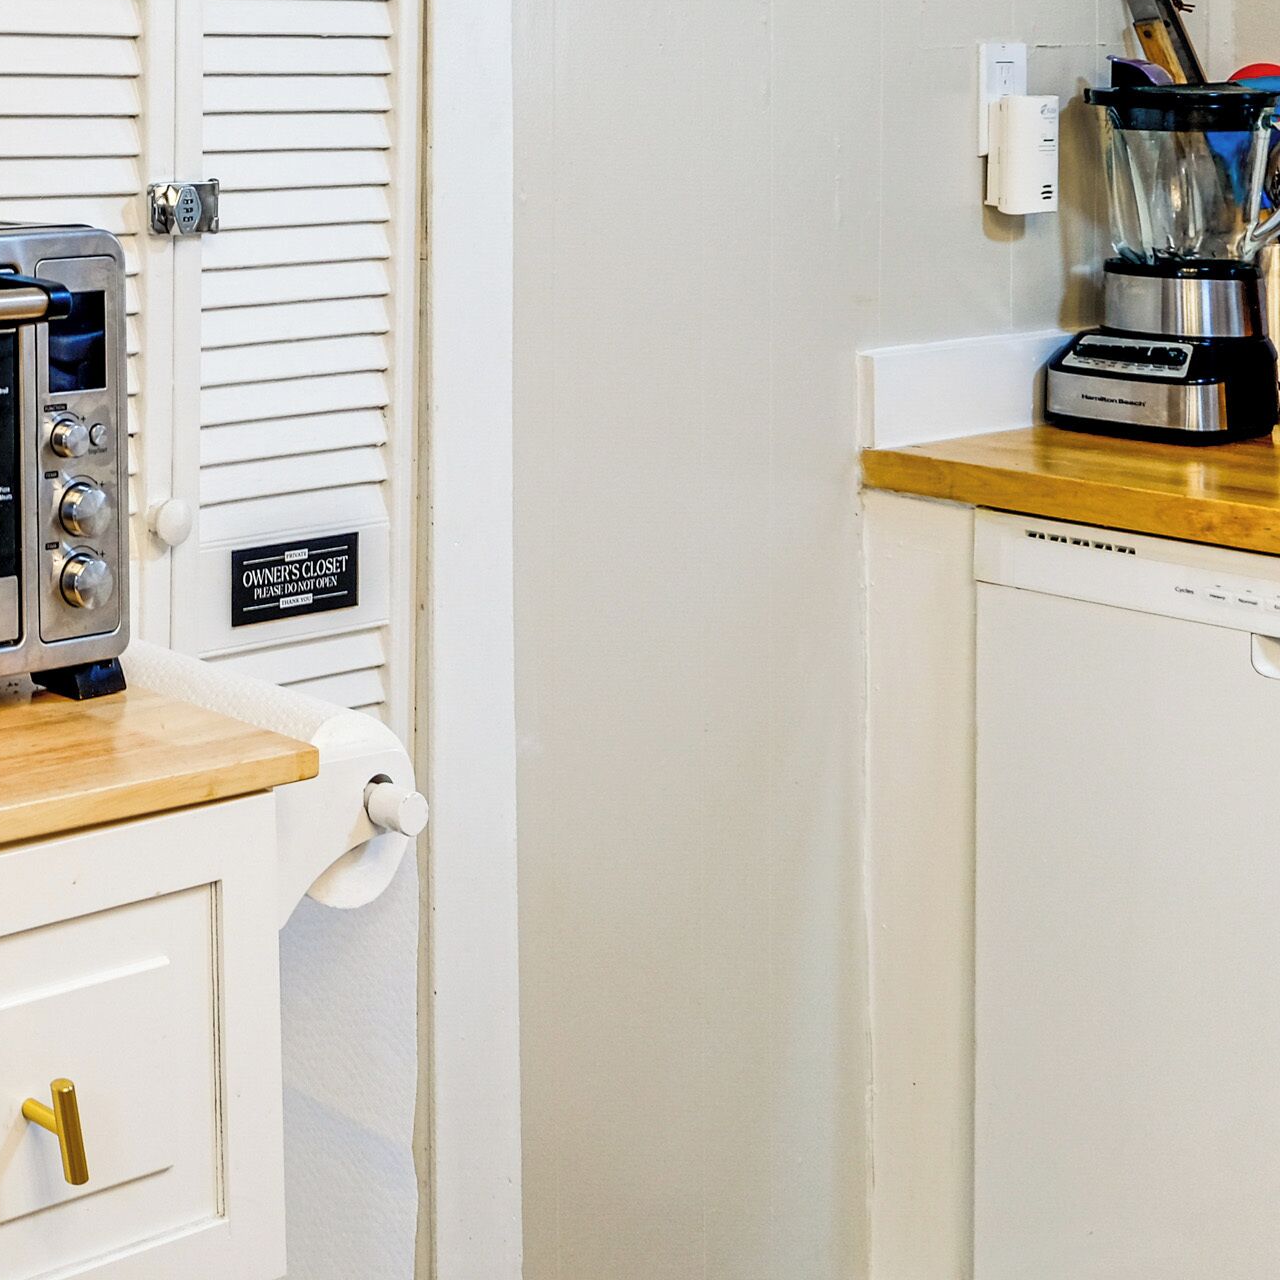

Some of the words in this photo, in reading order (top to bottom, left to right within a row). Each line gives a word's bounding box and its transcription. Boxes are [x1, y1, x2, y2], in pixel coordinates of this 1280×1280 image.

[1081, 393, 1118, 404] Hamilton
[1118, 398, 1144, 407] Beach
[286, 550, 307, 559] PRIVATE
[243, 563, 300, 588] OWNER'S
[302, 555, 348, 578] CLOSET
[254, 584, 284, 600] PLEASE
[285, 582, 297, 594] DO
[299, 579, 315, 592] NOT
[316, 575, 338, 589] OPEN
[282, 597, 300, 606] THANK
[301, 595, 312, 604] YOU
